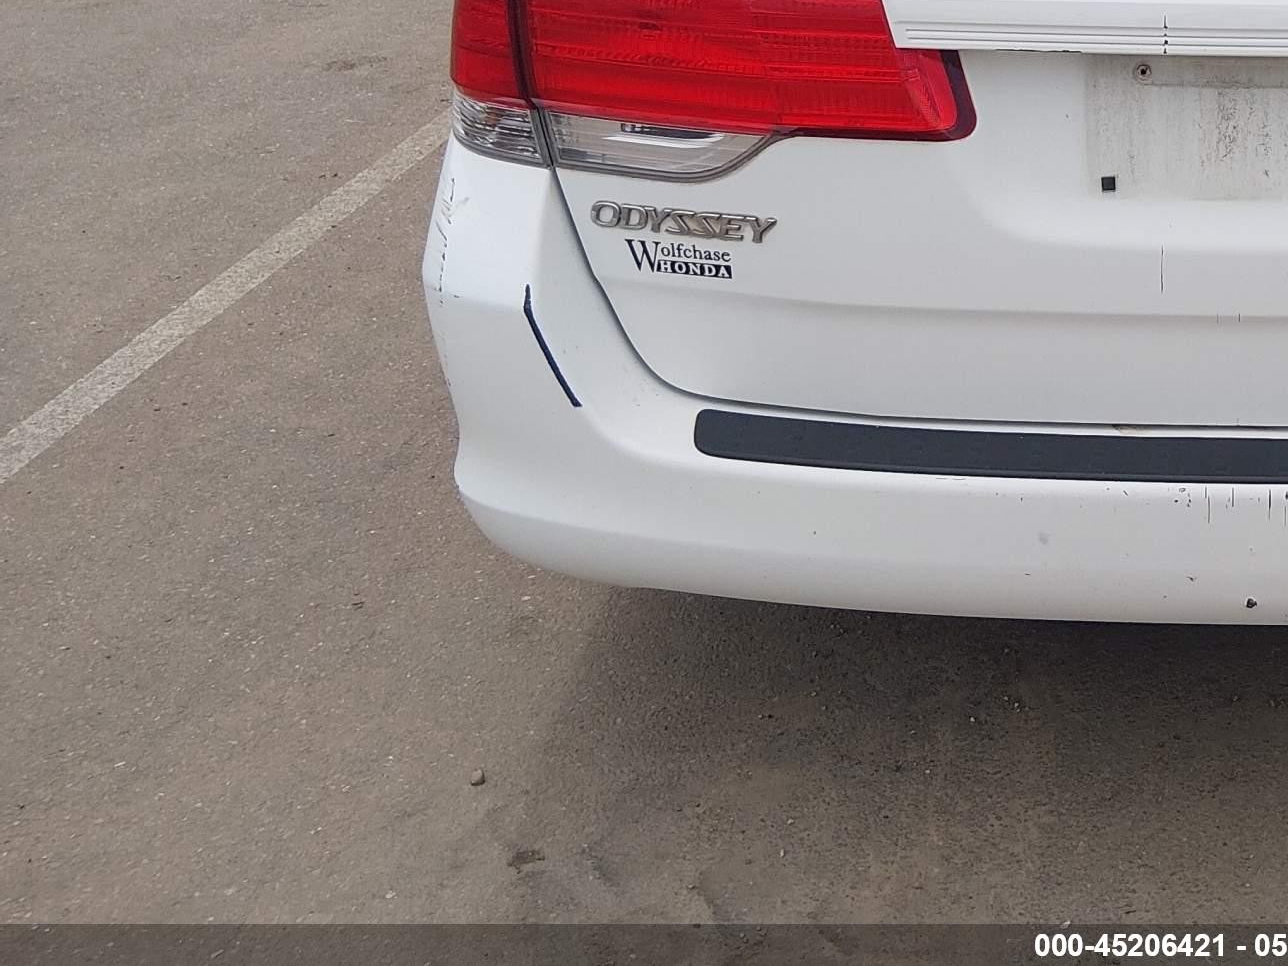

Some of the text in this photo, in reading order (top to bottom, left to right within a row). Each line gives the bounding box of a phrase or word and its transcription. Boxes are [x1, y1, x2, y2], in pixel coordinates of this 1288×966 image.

[590, 200, 778, 244] ODYSSEY
[624, 238, 732, 273] Wolfchase
[658, 261, 731, 279] HONDA
